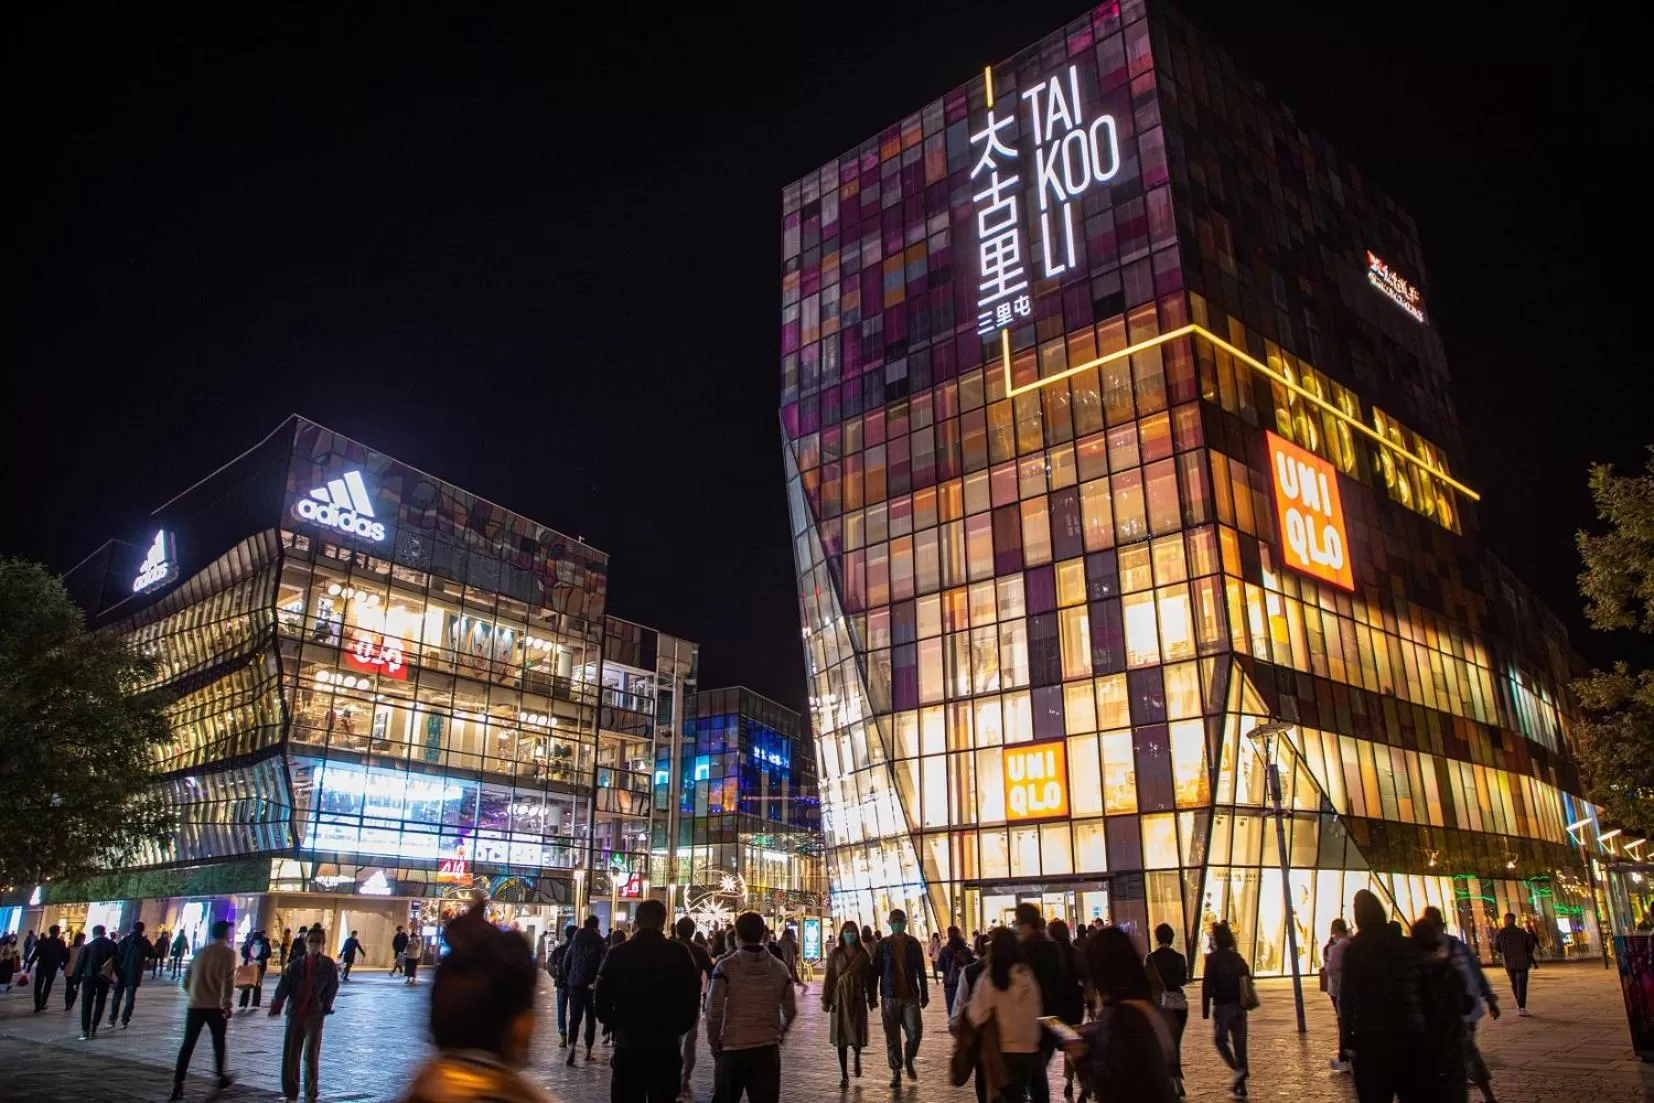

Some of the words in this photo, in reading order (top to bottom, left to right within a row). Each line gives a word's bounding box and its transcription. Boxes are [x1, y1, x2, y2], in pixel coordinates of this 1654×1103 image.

[1021, 65, 1082, 145] TAI
[1036, 114, 1120, 210] KOO
[969, 111, 1028, 307] 太古里
[1041, 203, 1076, 278] LI
[978, 295, 1031, 335] 三里屯
[1276, 450, 1332, 517] UNI
[298, 499, 385, 541] adidas
[1286, 507, 1344, 570] QLO
[133, 562, 169, 593] adidas
[1008, 750, 1056, 782] UNI
[1009, 781, 1061, 816] QLO
